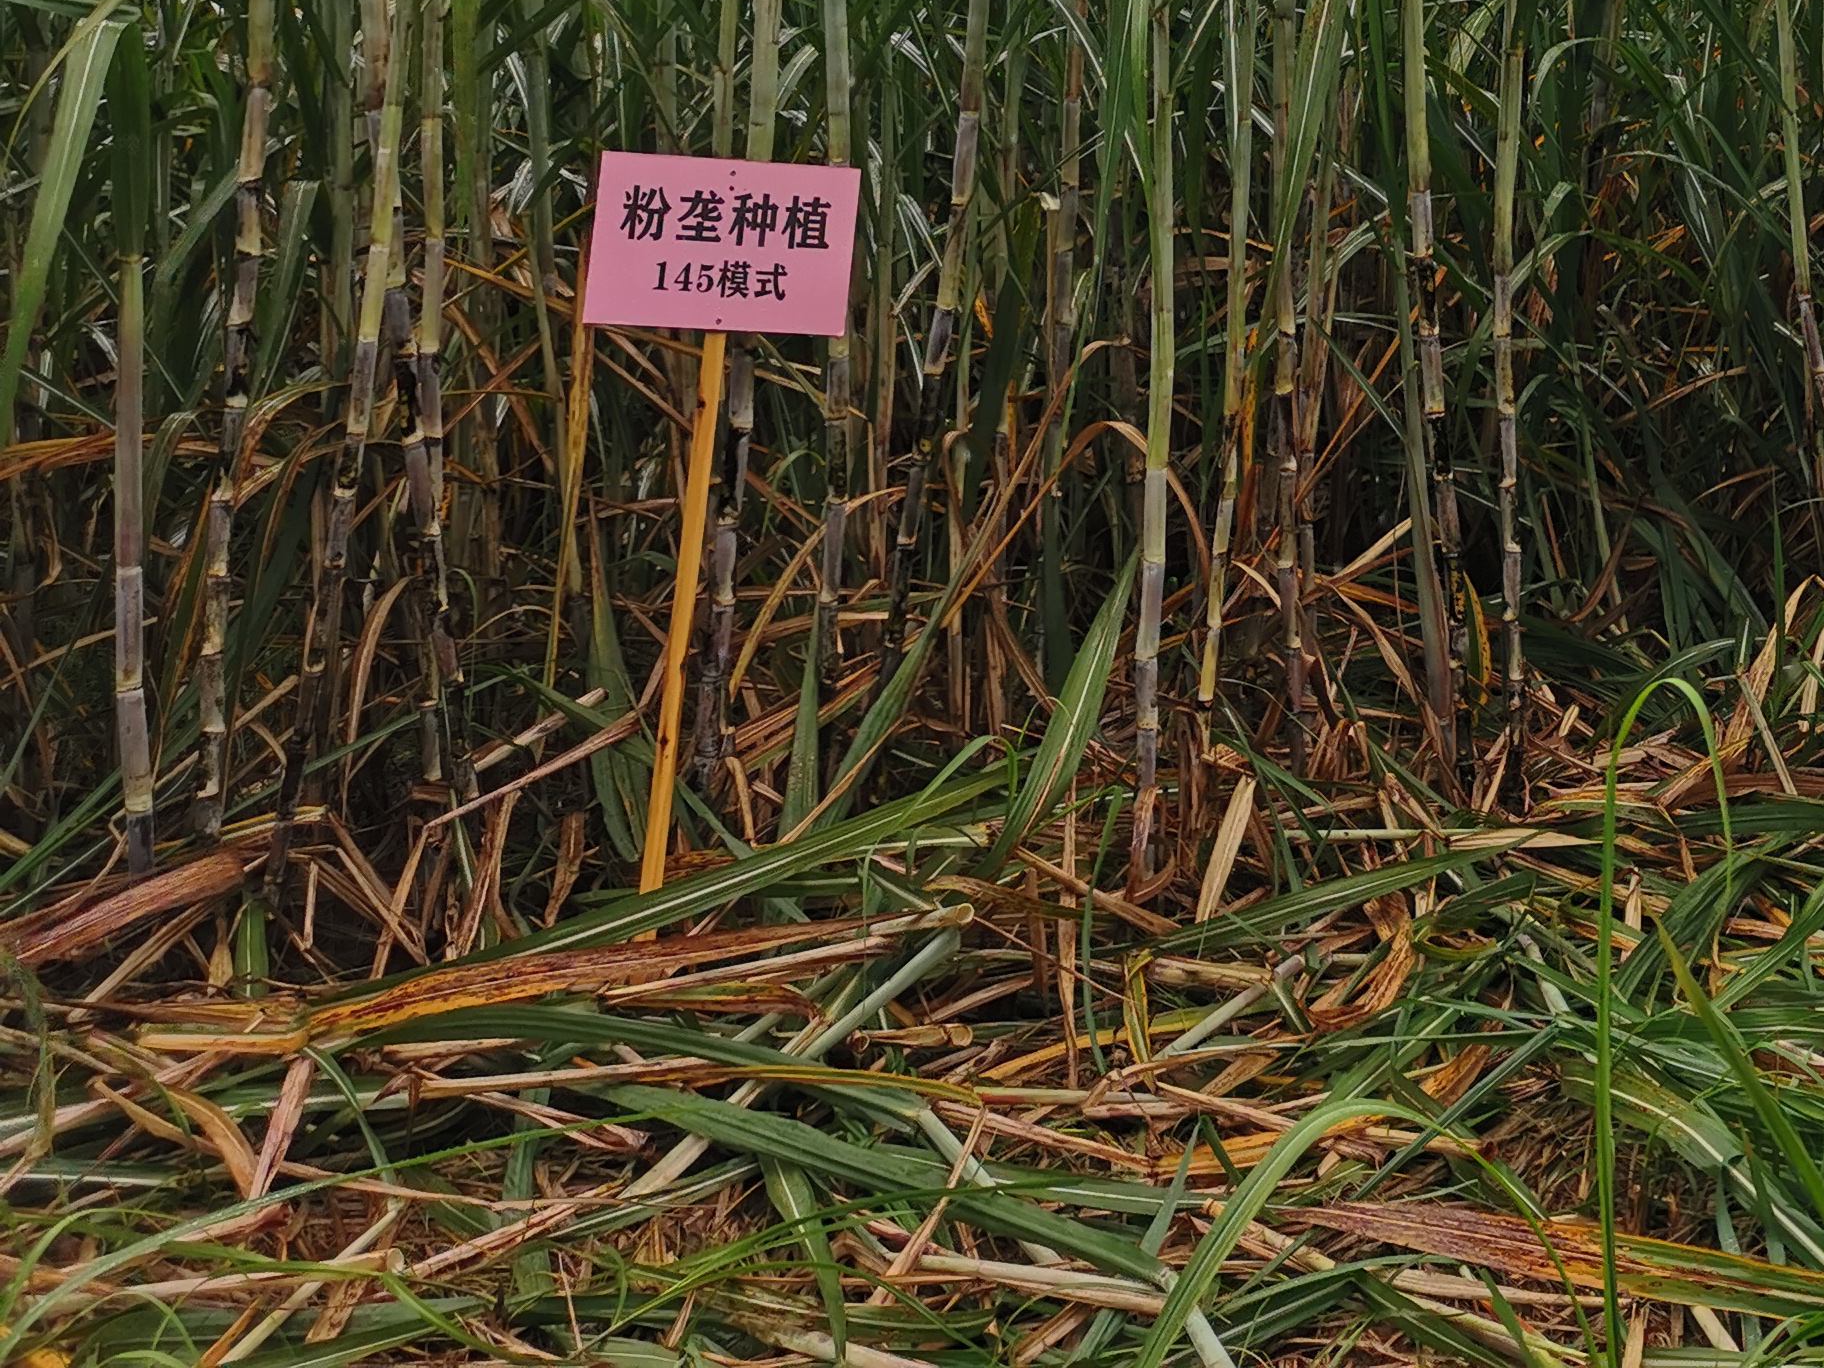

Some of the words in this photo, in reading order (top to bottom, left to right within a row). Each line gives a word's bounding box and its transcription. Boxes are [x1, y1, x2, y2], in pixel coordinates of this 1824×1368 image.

[619, 185, 831, 249] 粉垄种植
[651, 259, 788, 301] 145模式
